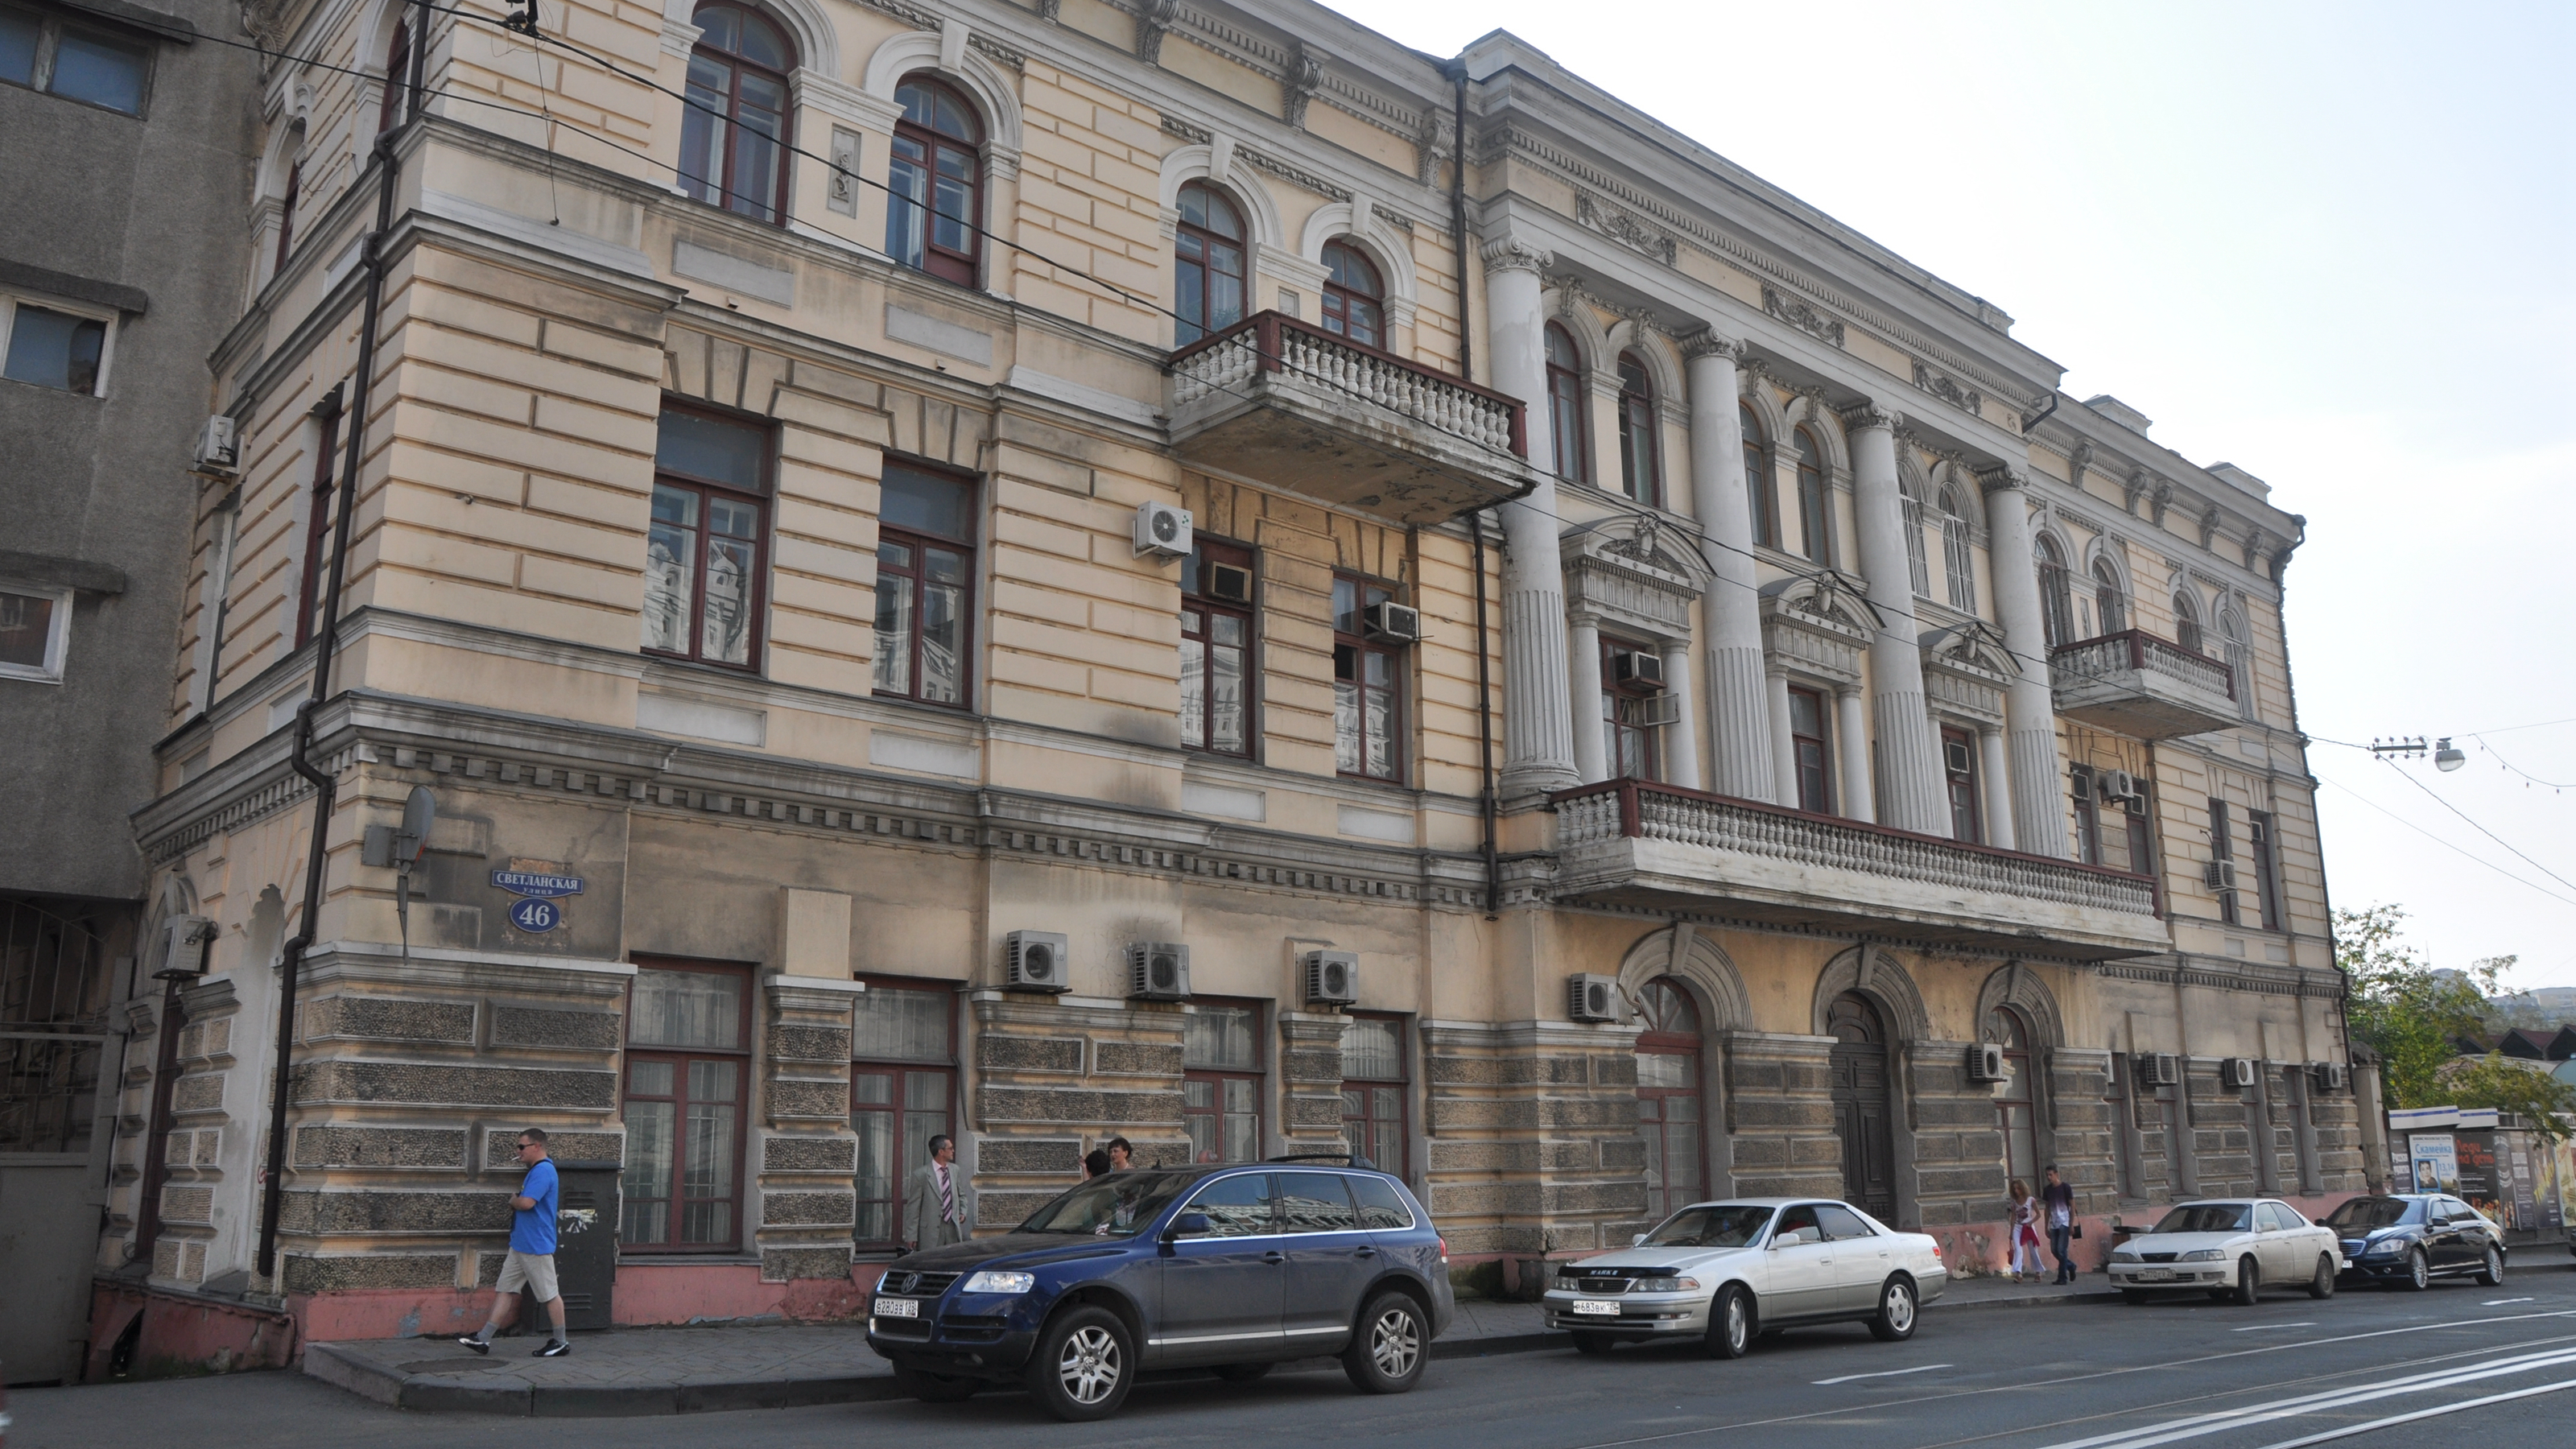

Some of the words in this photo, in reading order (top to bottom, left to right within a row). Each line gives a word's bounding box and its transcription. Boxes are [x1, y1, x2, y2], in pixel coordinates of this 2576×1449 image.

[497, 873, 578, 890] СВЕТЛАНСКАЯ
[522, 887, 553, 895] улица
[519, 904, 550, 927] 46
[2415, 1143, 2452, 1154] Скамейка
